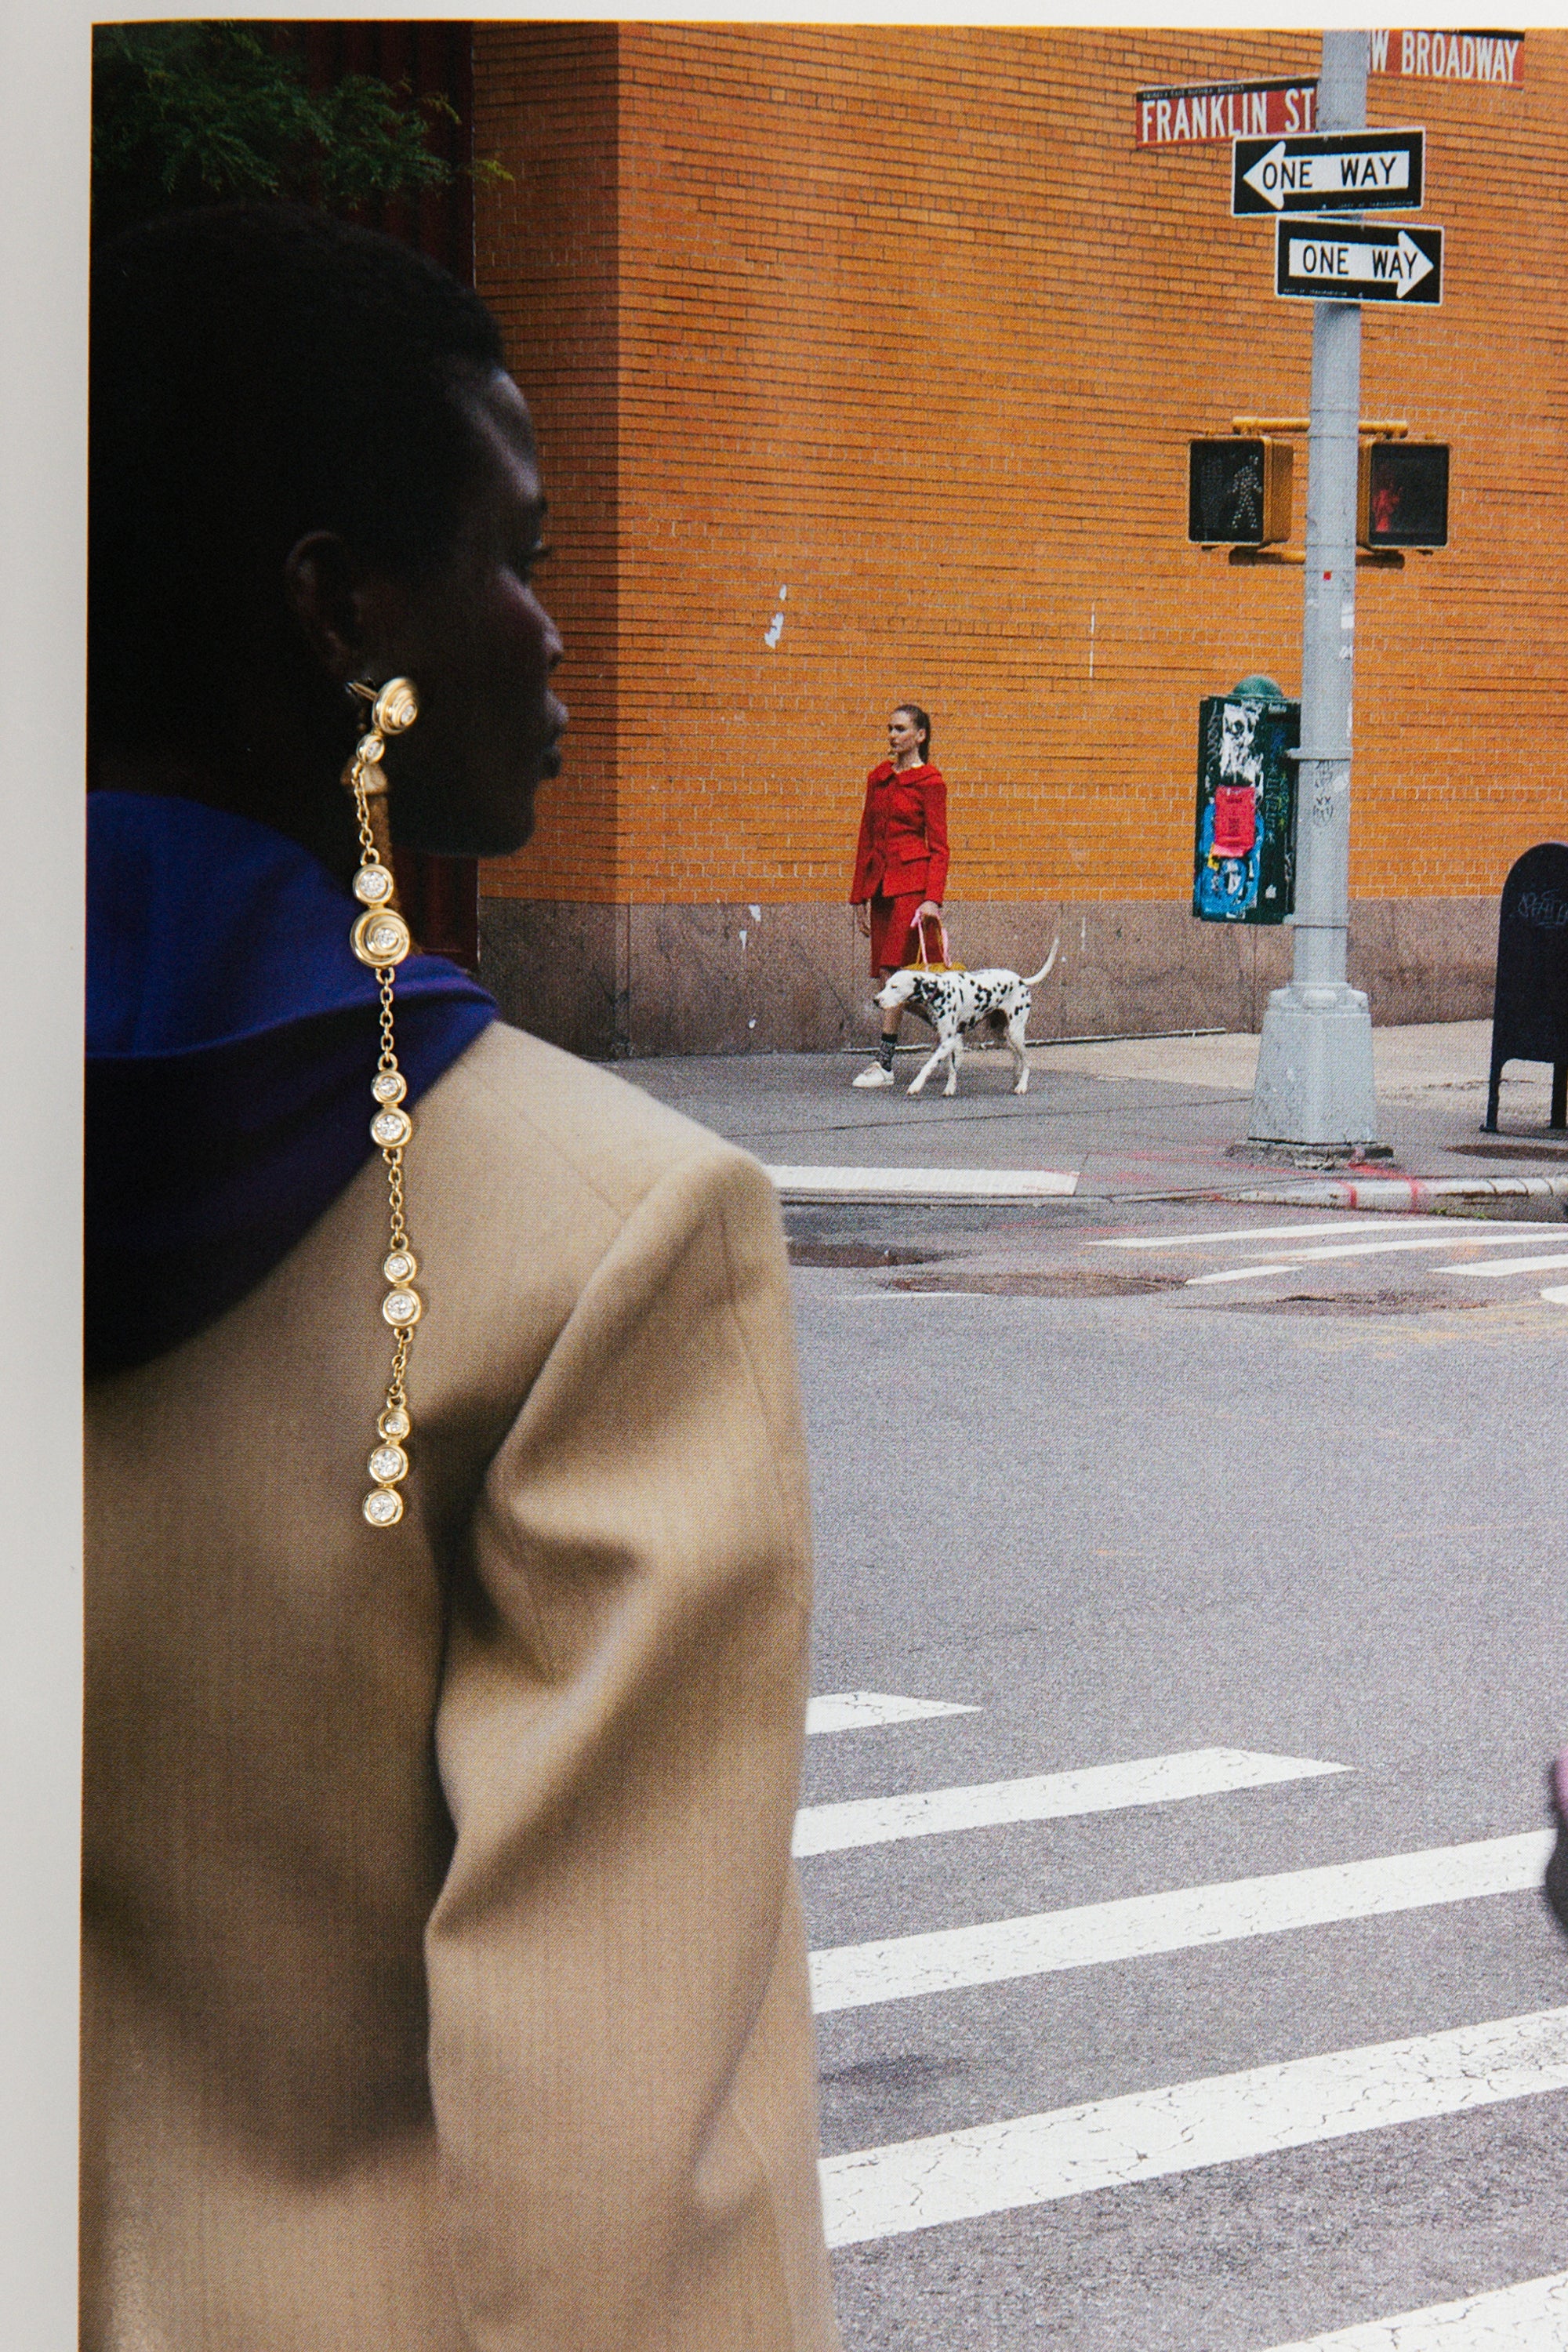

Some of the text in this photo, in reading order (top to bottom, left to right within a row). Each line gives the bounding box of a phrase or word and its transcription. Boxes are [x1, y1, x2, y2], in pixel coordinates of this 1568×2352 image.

[1372, 30, 1519, 83] W BROADWAY
[1142, 86, 1316, 143] FRANKLIN ST
[1262, 156, 1397, 190] ONE WAY
[1303, 245, 1418, 279] ONE WAY
